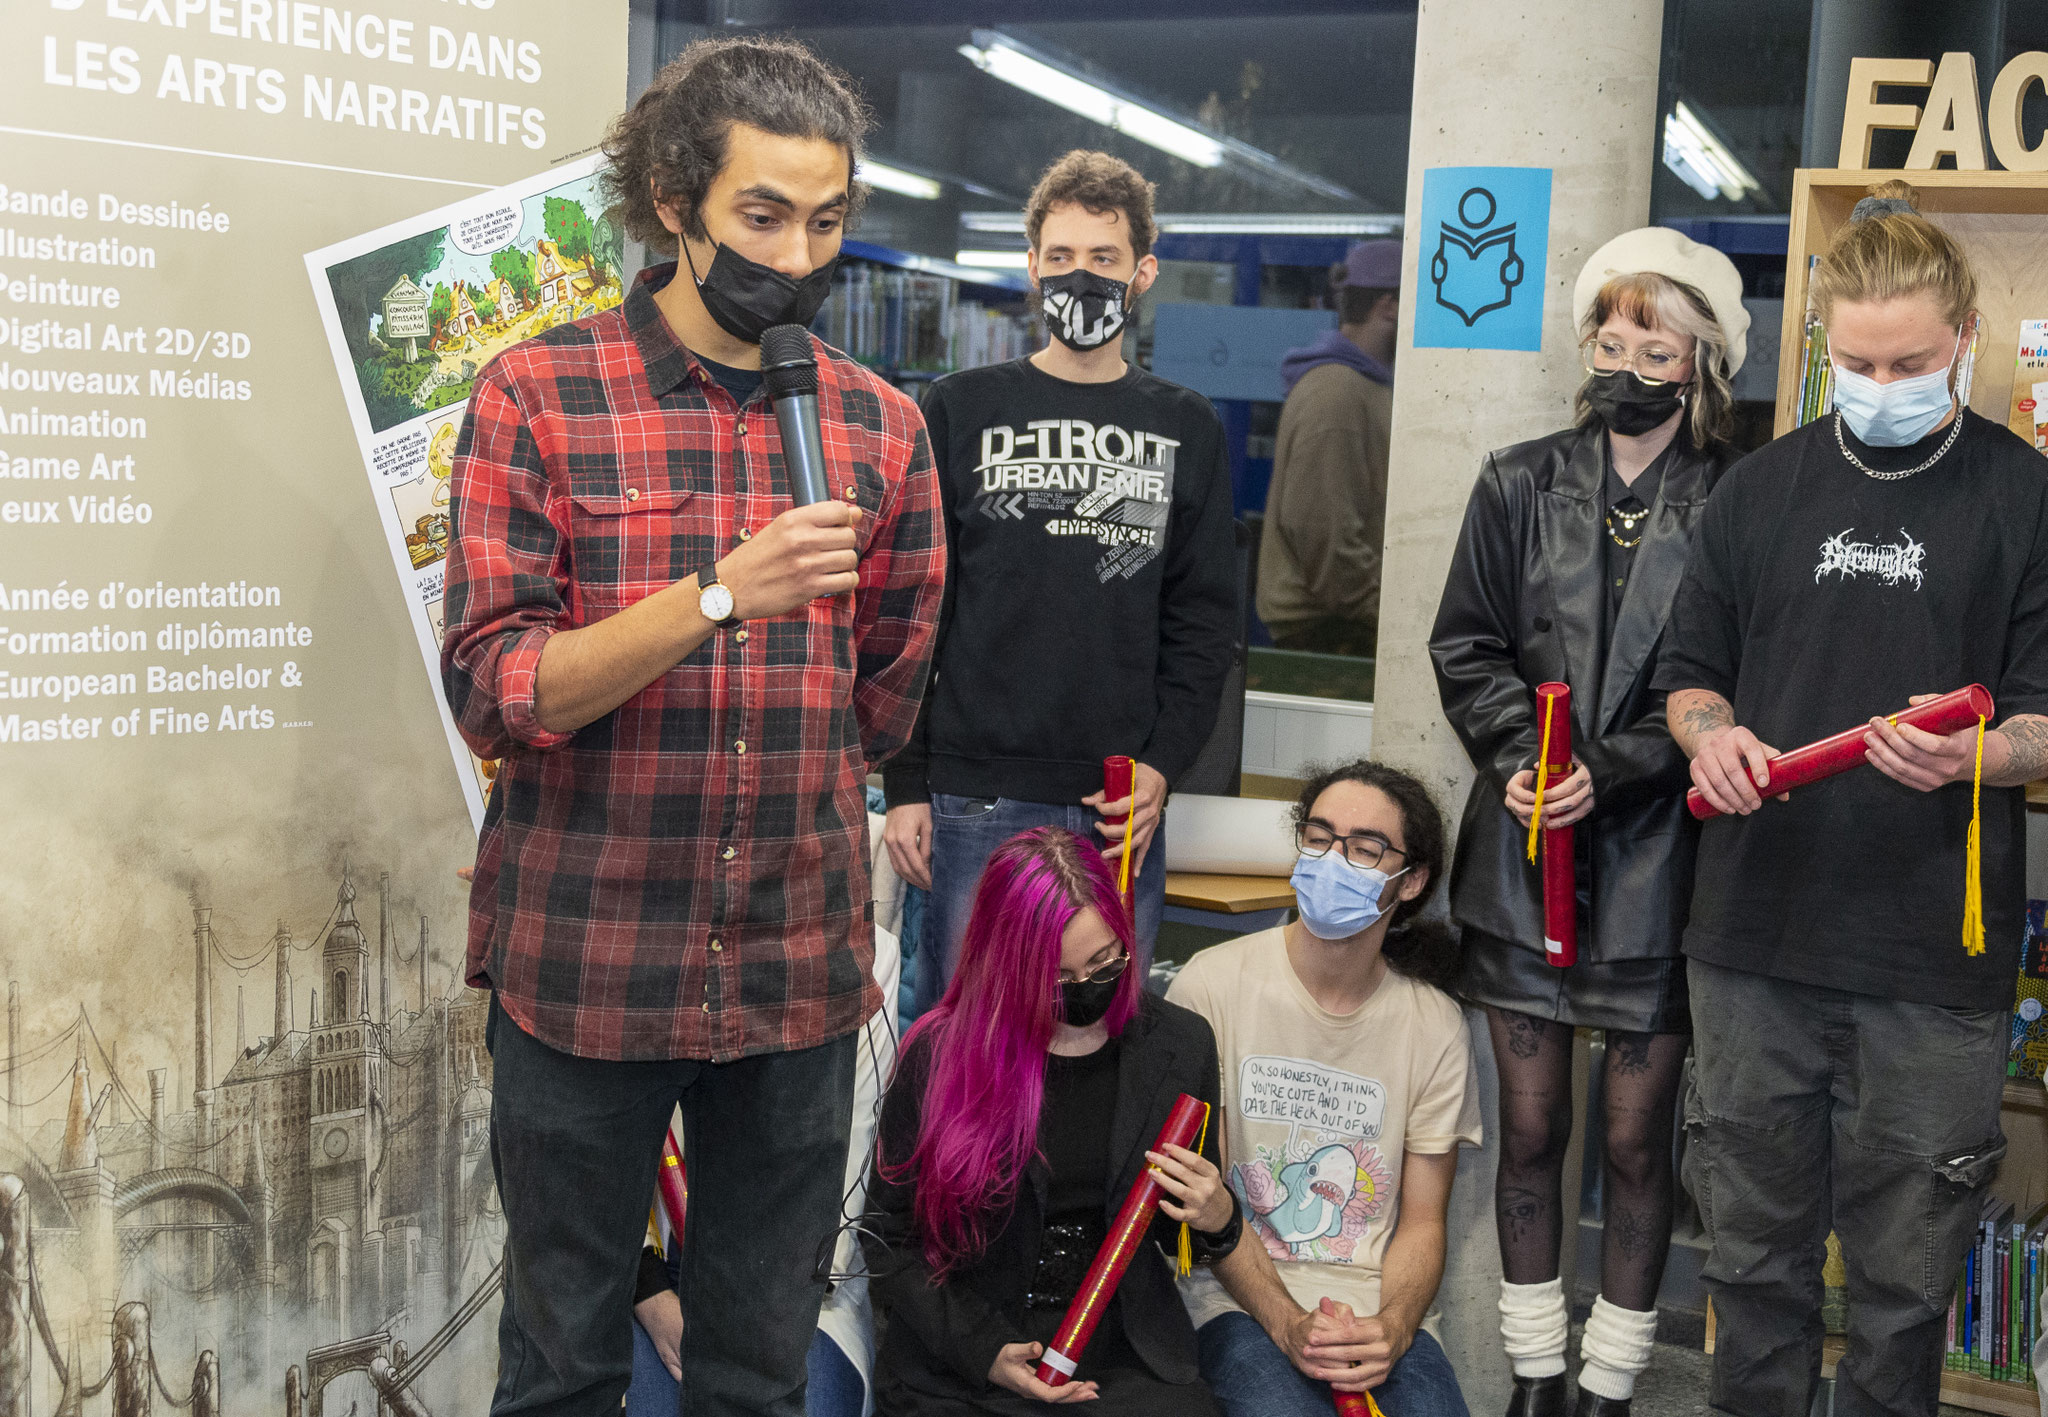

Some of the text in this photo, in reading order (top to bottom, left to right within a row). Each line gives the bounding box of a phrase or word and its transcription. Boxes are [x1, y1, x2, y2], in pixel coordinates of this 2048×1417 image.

[429, 25, 542, 83] DANS
[44, 36, 546, 150] LES ARTS NARRATIFS
[99, 194, 230, 233] Dessinée
[0, 228, 156, 268] llustration
[101, 324, 147, 353] Art
[155, 327, 251, 362] 2D/3D
[150, 369, 252, 401] Médias
[982, 419, 1181, 466] D-TROIT
[89, 453, 136, 481] Art
[984, 464, 1090, 491] URBAN
[0, 494, 152, 524] eux Vidéo
[1099, 562, 1122, 583] URBAN
[156, 620, 313, 655] diplômante
[147, 663, 272, 693] Bachelor
[280, 661, 303, 688] &
[0, 713, 102, 743] Master
[111, 708, 140, 737] of
[150, 707, 209, 735] Fine
[217, 704, 275, 731] Arts
[1251, 1063, 1265, 1076] OK
[1267, 1066, 1279, 1077] SO
[1280, 1067, 1331, 1093] HONESTLY,
[1341, 1082, 1377, 1098] THINK
[1251, 1081, 1367, 1115] YOU'RE CUTE AND I'D
[1244, 1097, 1378, 1136] DATE THE HECK OUT OF YOU
